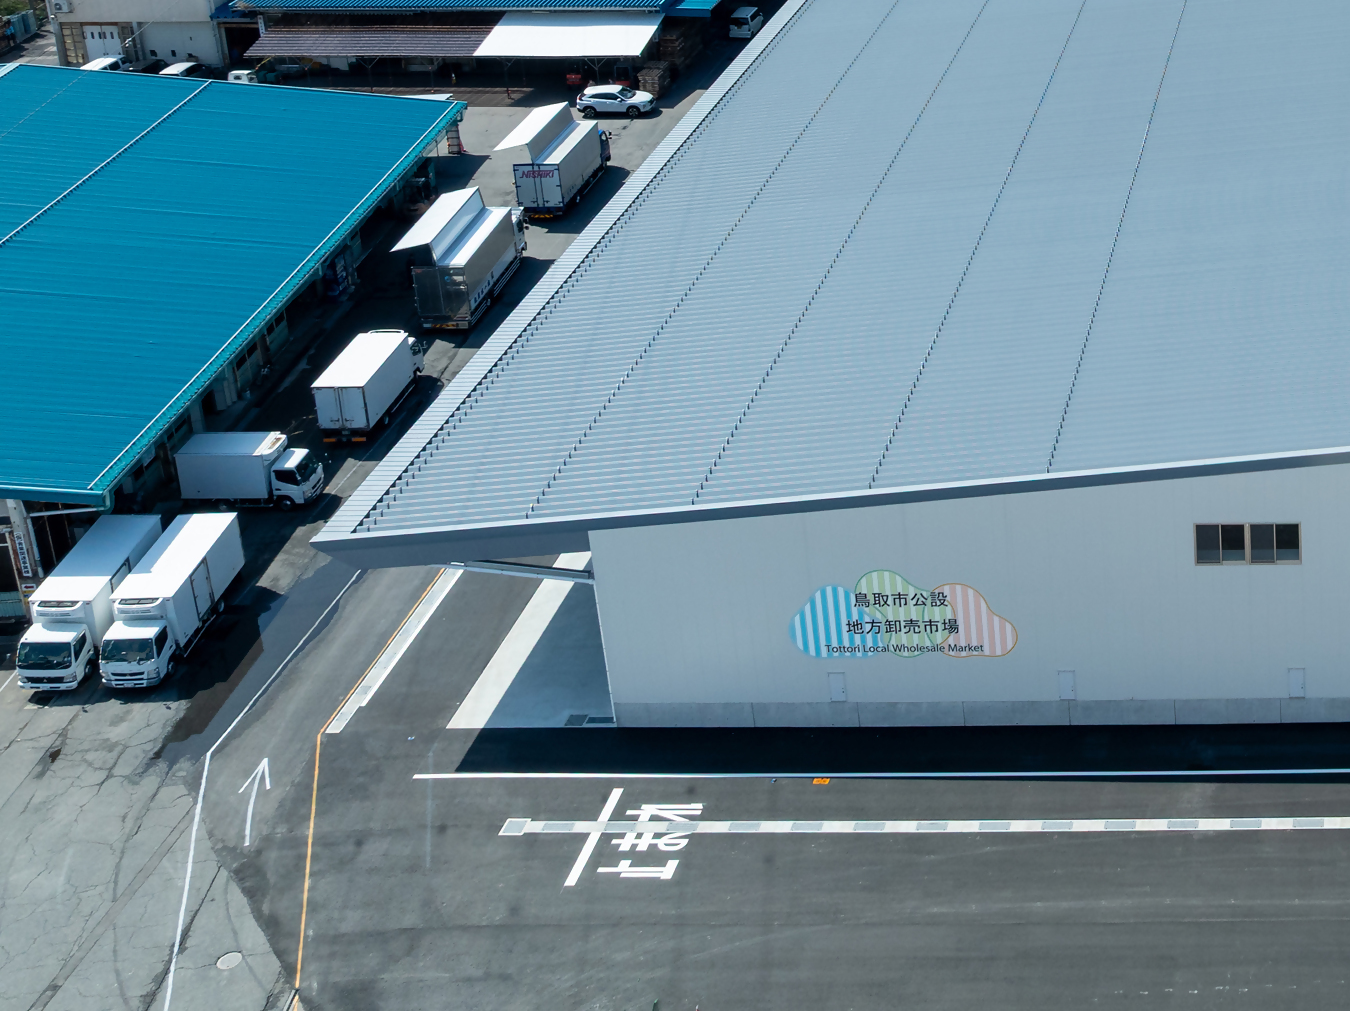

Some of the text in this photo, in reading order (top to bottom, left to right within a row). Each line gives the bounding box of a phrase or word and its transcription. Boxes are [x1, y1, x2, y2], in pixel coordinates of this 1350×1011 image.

[519, 170, 555, 179] NISHIKI
[854, 591, 949, 608] 鳥取市公設
[846, 618, 960, 635] 地方卸売市場
[825, 644, 984, 653] Tottori Local Wholesale Market
[597, 802, 704, 880] 止まれ
